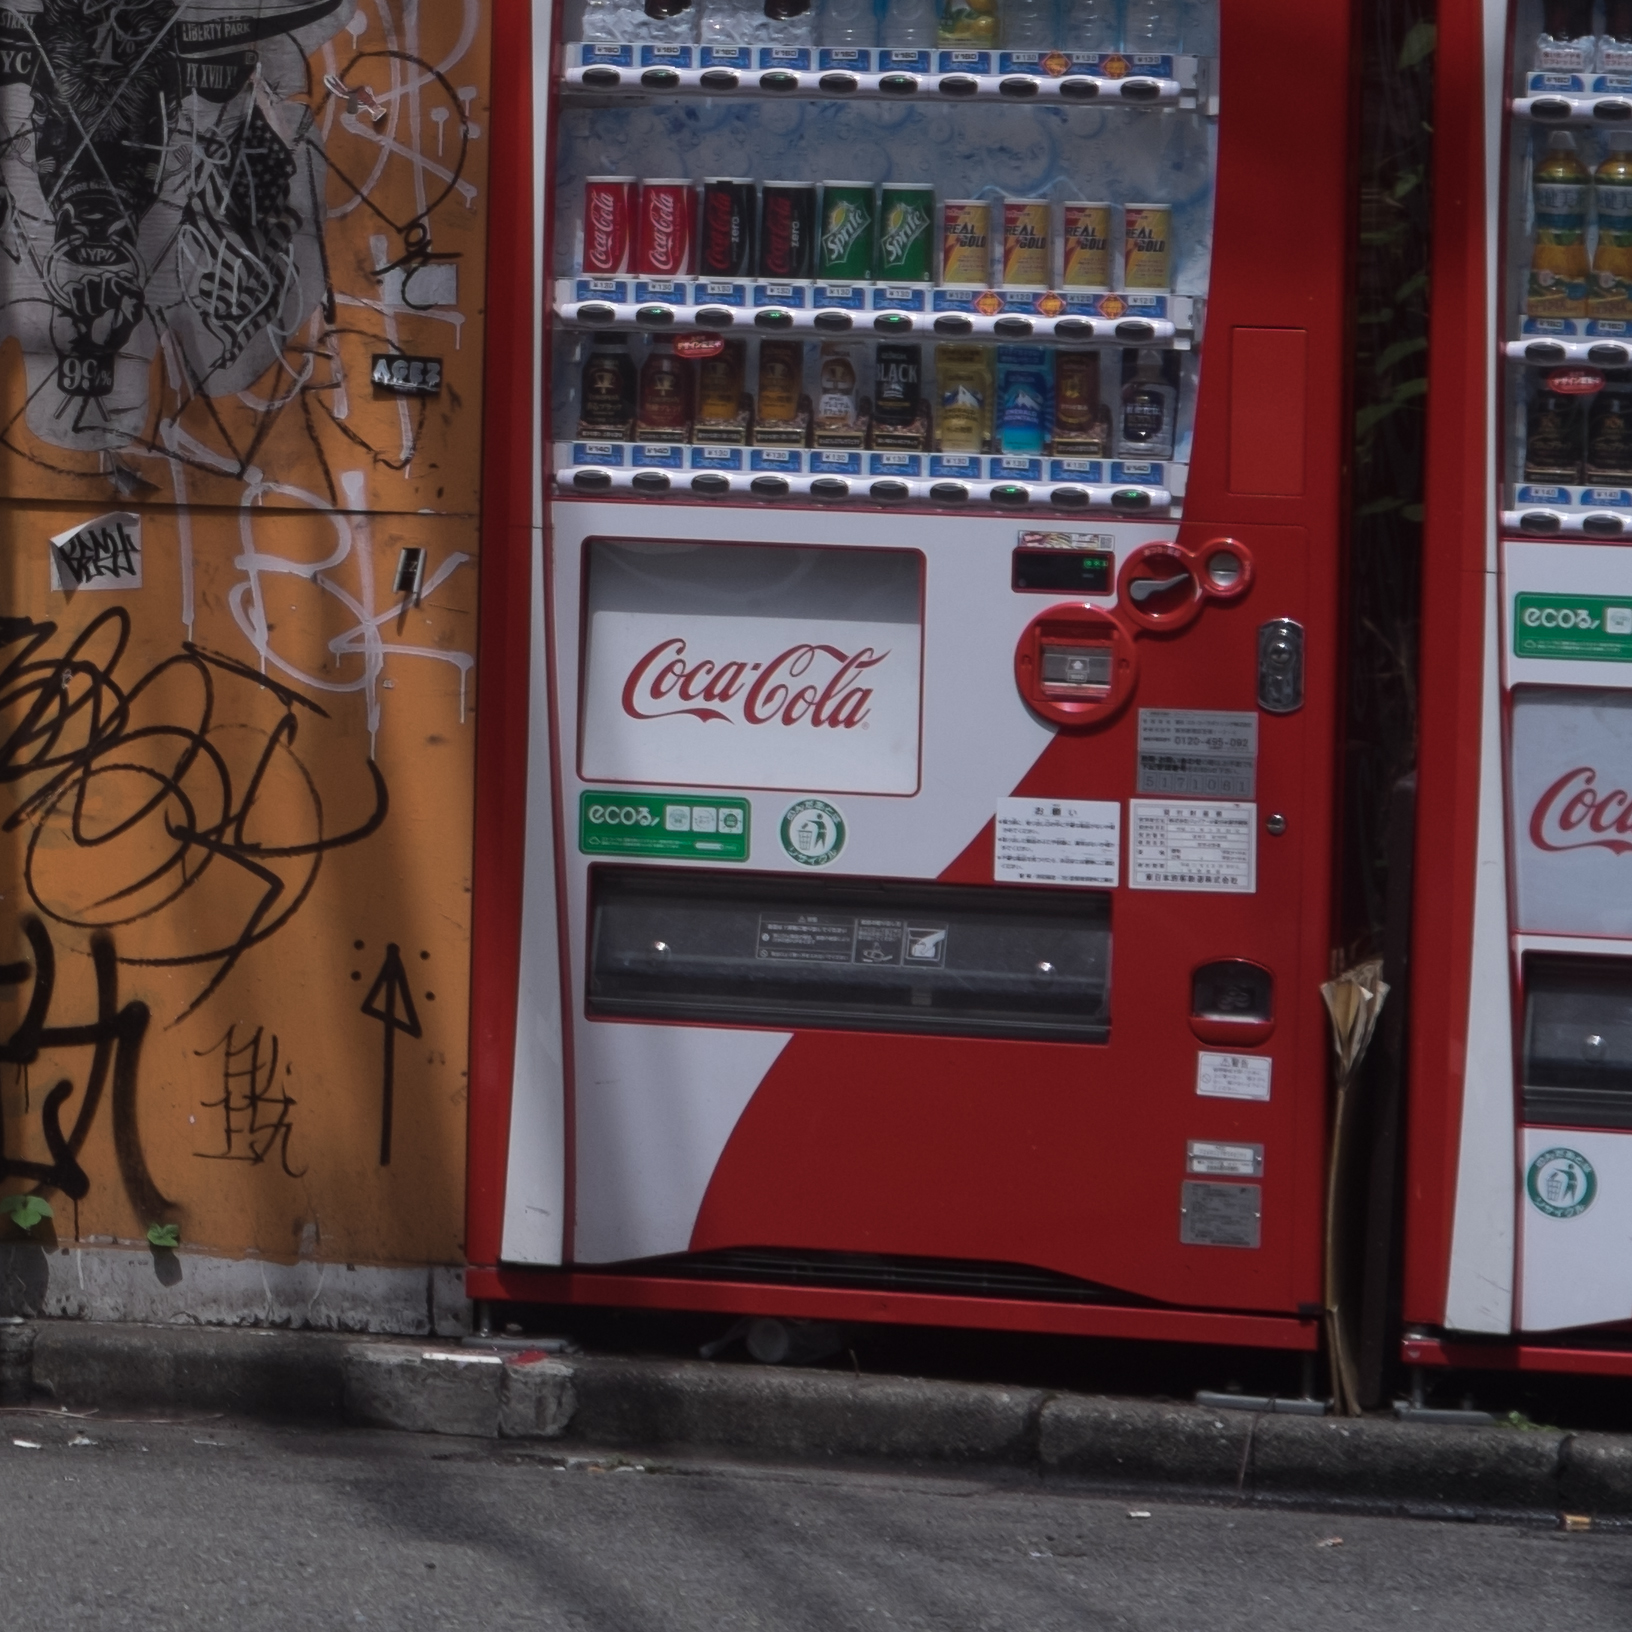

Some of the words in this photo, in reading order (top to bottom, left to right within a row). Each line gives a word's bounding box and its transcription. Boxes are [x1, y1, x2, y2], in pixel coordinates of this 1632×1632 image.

[182, 22, 223, 43] LIBERTY
[223, 20, 251, 38] PARK
[589, 188, 615, 269] Coca-Cola
[649, 188, 674, 270] Coca-Cola
[827, 209, 863, 261] Sprite
[885, 211, 921, 262] Sprite
[946, 221, 976, 235] REAL
[1006, 223, 1036, 236] REAL
[1066, 223, 1097, 238] REAL
[1125, 225, 1154, 240] REAL
[621, 637, 892, 732] Coca-Cola
